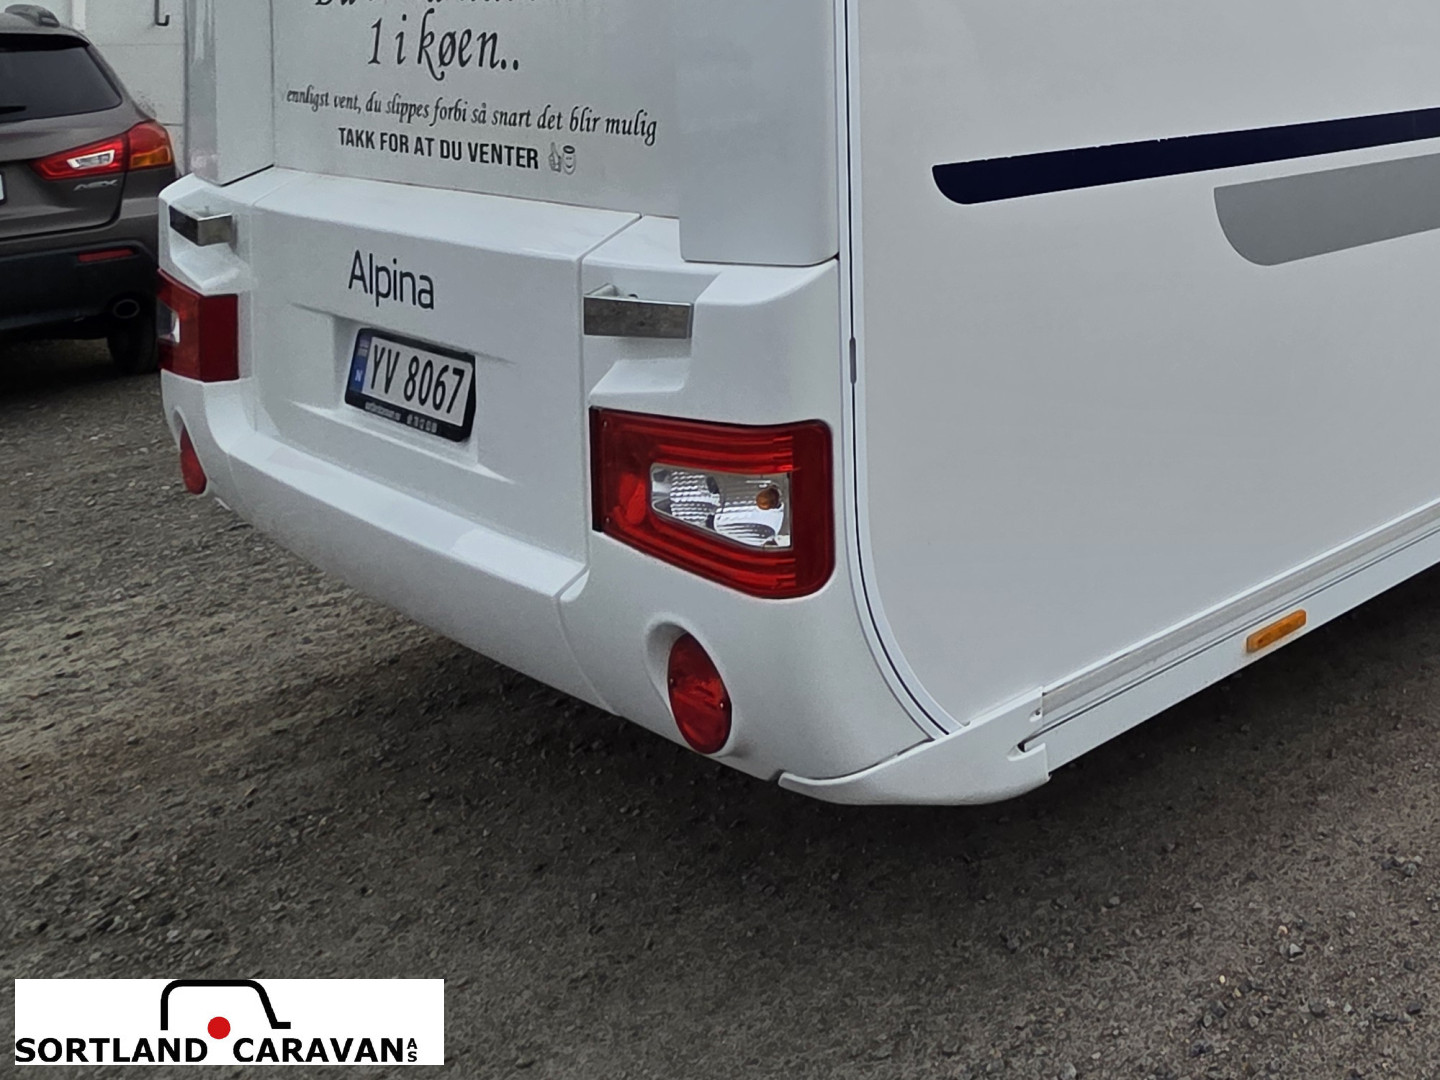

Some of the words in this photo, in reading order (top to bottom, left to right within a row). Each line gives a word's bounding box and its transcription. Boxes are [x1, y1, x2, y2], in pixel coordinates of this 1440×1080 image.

[367, 17, 383, 65] 1
[395, 13, 407, 65] i
[417, 8, 519, 81] køen..
[333, 94, 361, 114] vent,
[365, 91, 381, 112] du
[385, 93, 430, 124] slippes
[429, 97, 467, 127] forbi
[470, 102, 487, 125] så
[491, 109, 532, 128] snart
[536, 104, 563, 131] det
[569, 106, 601, 133] blir
[605, 109, 657, 147] mulig
[338, 127, 375, 150] TAKK
[380, 132, 409, 154] FOR
[413, 136, 435, 158] AT
[440, 139, 463, 161] DU
[468, 142, 539, 170] VENTER
[348, 249, 435, 310] Alpina
[370, 344, 401, 395] YV
[403, 355, 465, 414] 8067
